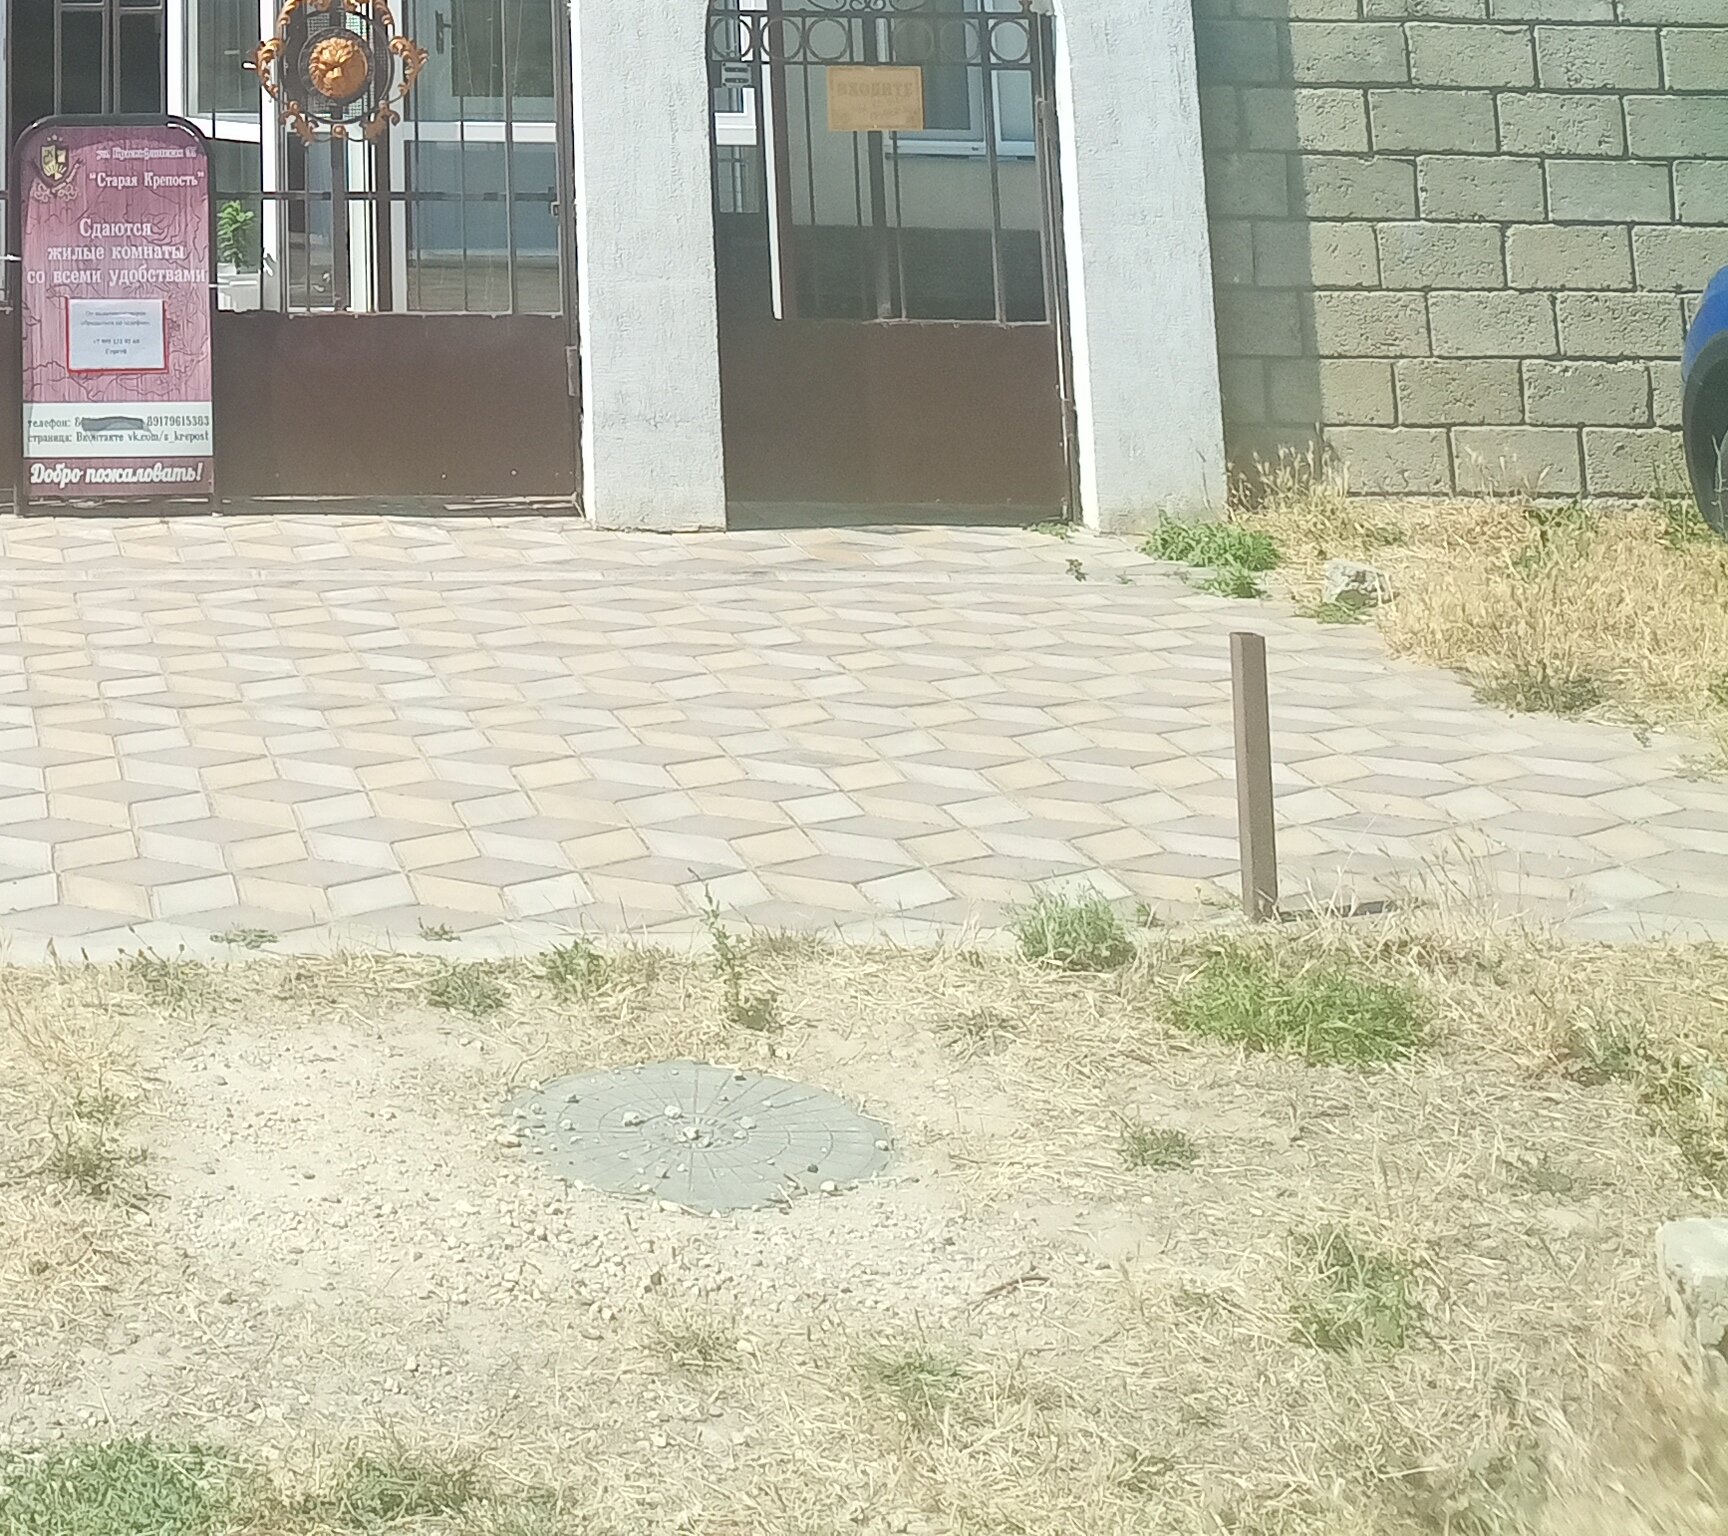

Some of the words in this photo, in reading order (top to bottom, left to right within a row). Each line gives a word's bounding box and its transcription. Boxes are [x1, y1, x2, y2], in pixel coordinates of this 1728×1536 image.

[79, 217, 152, 238] Сдаются
[48, 245, 105, 261] жилые
[112, 245, 185, 260] комнаты
[27, 269, 46, 284] со
[53, 269, 102, 284] всеми
[109, 263, 206, 286] удобствами
[28, 416, 71, 431] телефон:
[28, 433, 72, 445] страница:
[30, 462, 83, 489] Добро
[85, 462, 204, 484] пожаловать!
